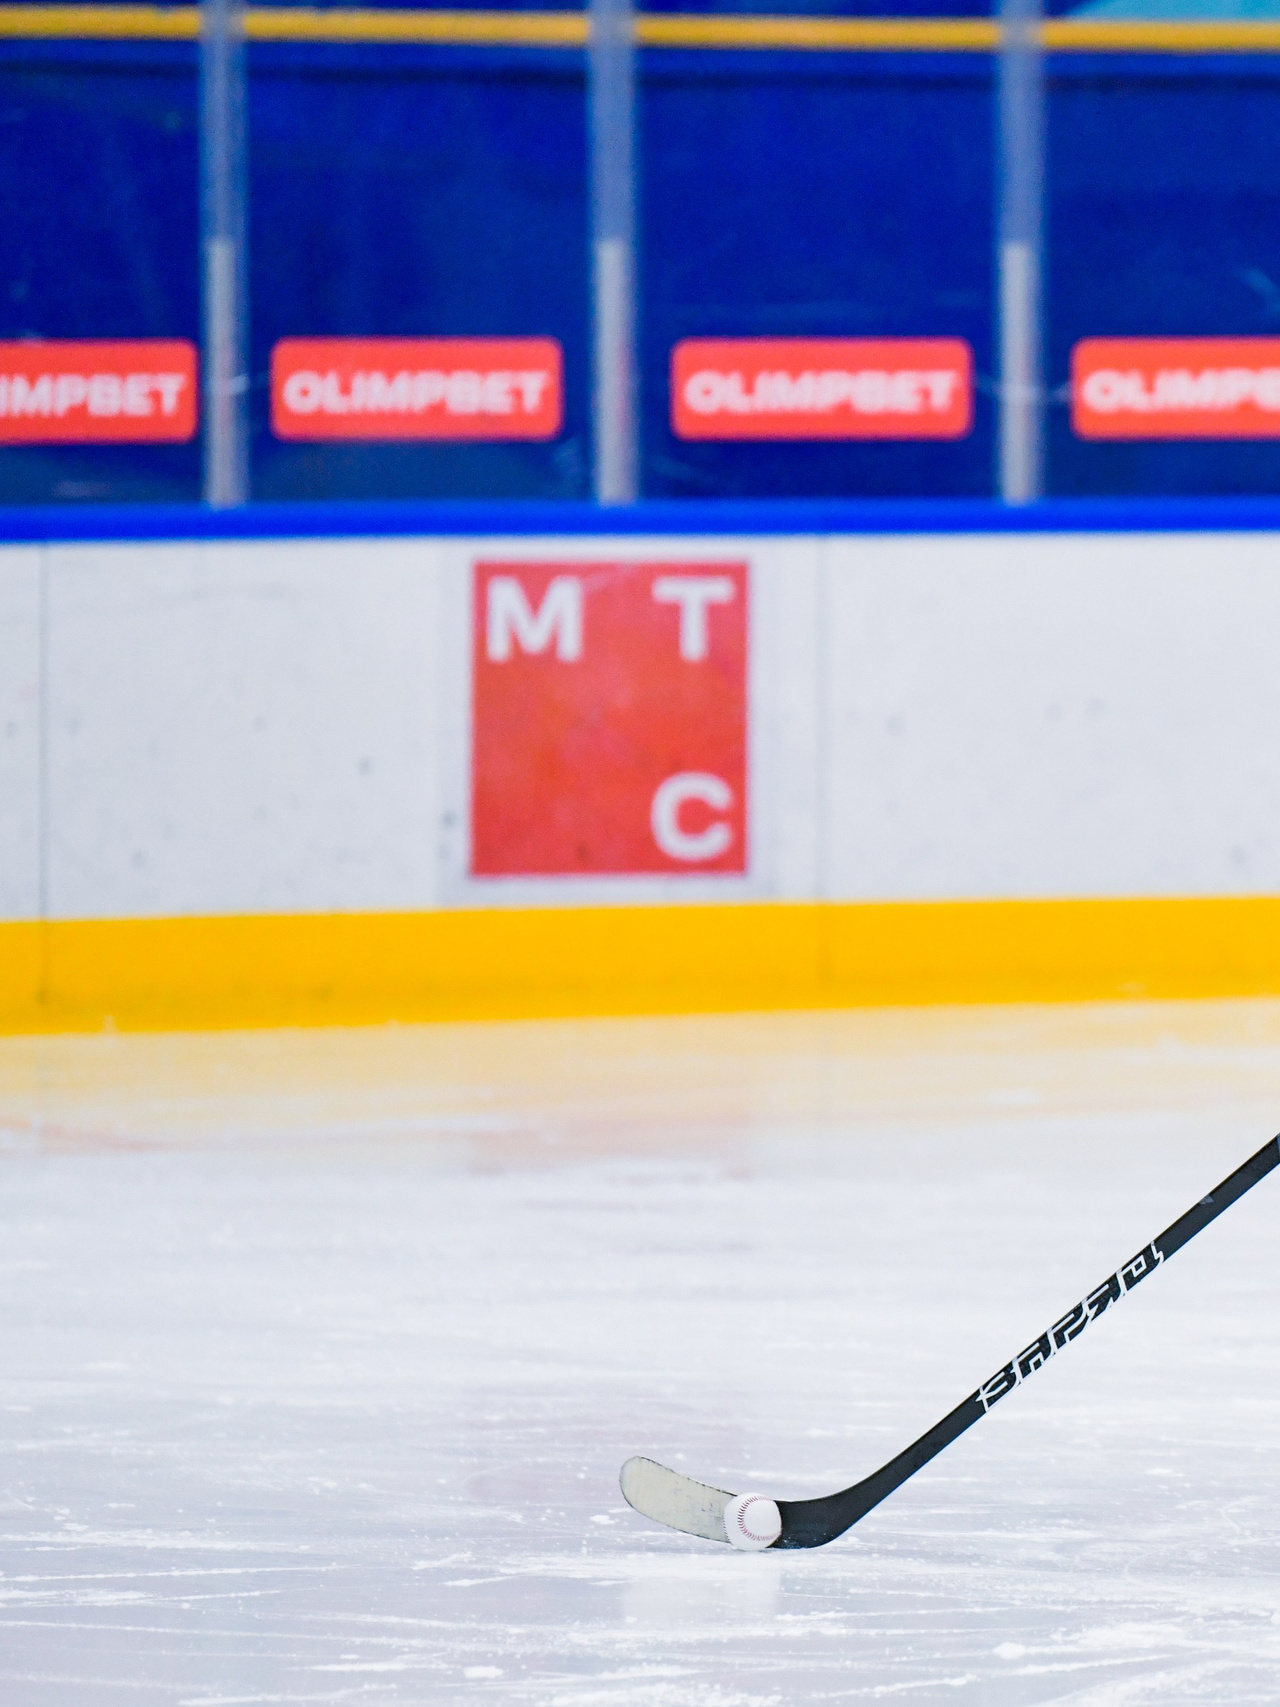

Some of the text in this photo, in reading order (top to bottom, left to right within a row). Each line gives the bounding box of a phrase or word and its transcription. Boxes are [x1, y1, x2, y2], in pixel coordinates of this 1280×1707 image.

[0, 374, 187, 416] IMPBET
[283, 370, 548, 414] OLIMPBET
[685, 370, 957, 414] OLIMPBET
